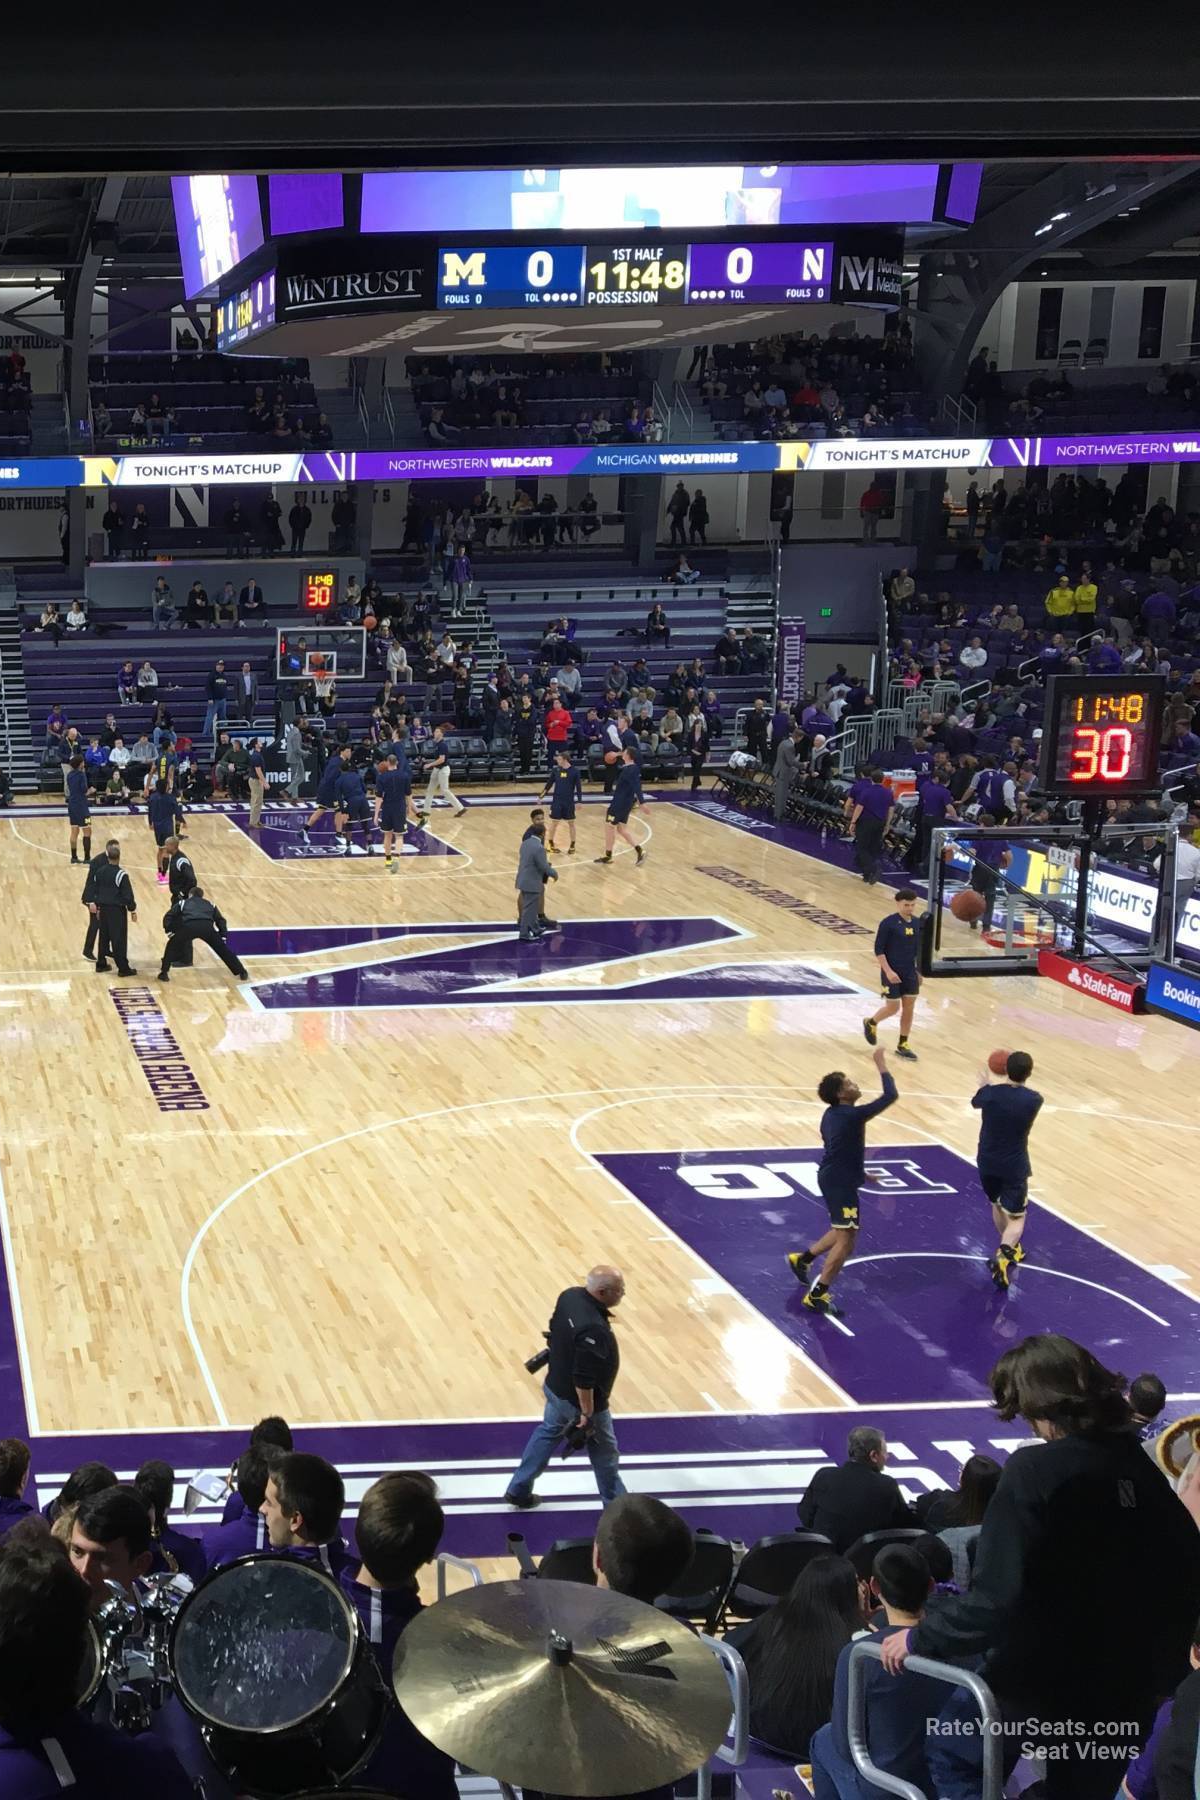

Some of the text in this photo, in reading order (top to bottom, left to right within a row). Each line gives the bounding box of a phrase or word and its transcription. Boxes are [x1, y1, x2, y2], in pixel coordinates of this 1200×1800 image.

[612, 248, 663, 261] 1ST HALF
[443, 253, 486, 286] M
[527, 251, 553, 287] 0
[726, 247, 753, 284] 0
[802, 249, 824, 281] N
[590, 260, 685, 290] 11:48
[285, 269, 422, 303] WINTRUST
[786, 288, 824, 298] FOULS 0
[445, 294, 482, 304] FOULS 0
[525, 293, 540, 303] TOL
[588, 291, 658, 304] POSSESSION
[730, 290, 745, 299] TOL
[826, 449, 899, 462] TONIGHT'S
[903, 448, 970, 460] MATCHUP
[1057, 443, 1169, 456] NORTHWESTERN
[388, 456, 552, 471] NORTHWESTERN WILDCATS
[597, 452, 738, 466] MICHIGAN WOLVERINES
[134, 465, 209, 477] TONIGHT'S
[213, 463, 282, 476] MATCHUP
[308, 574, 333, 586] 11:48
[308, 586, 330, 606] 30
[1074, 694, 1144, 724] 11:48
[1071, 728, 1132, 780] 30
[265, 767, 312, 783] meir
[143, 1063, 211, 1113] ARENA
